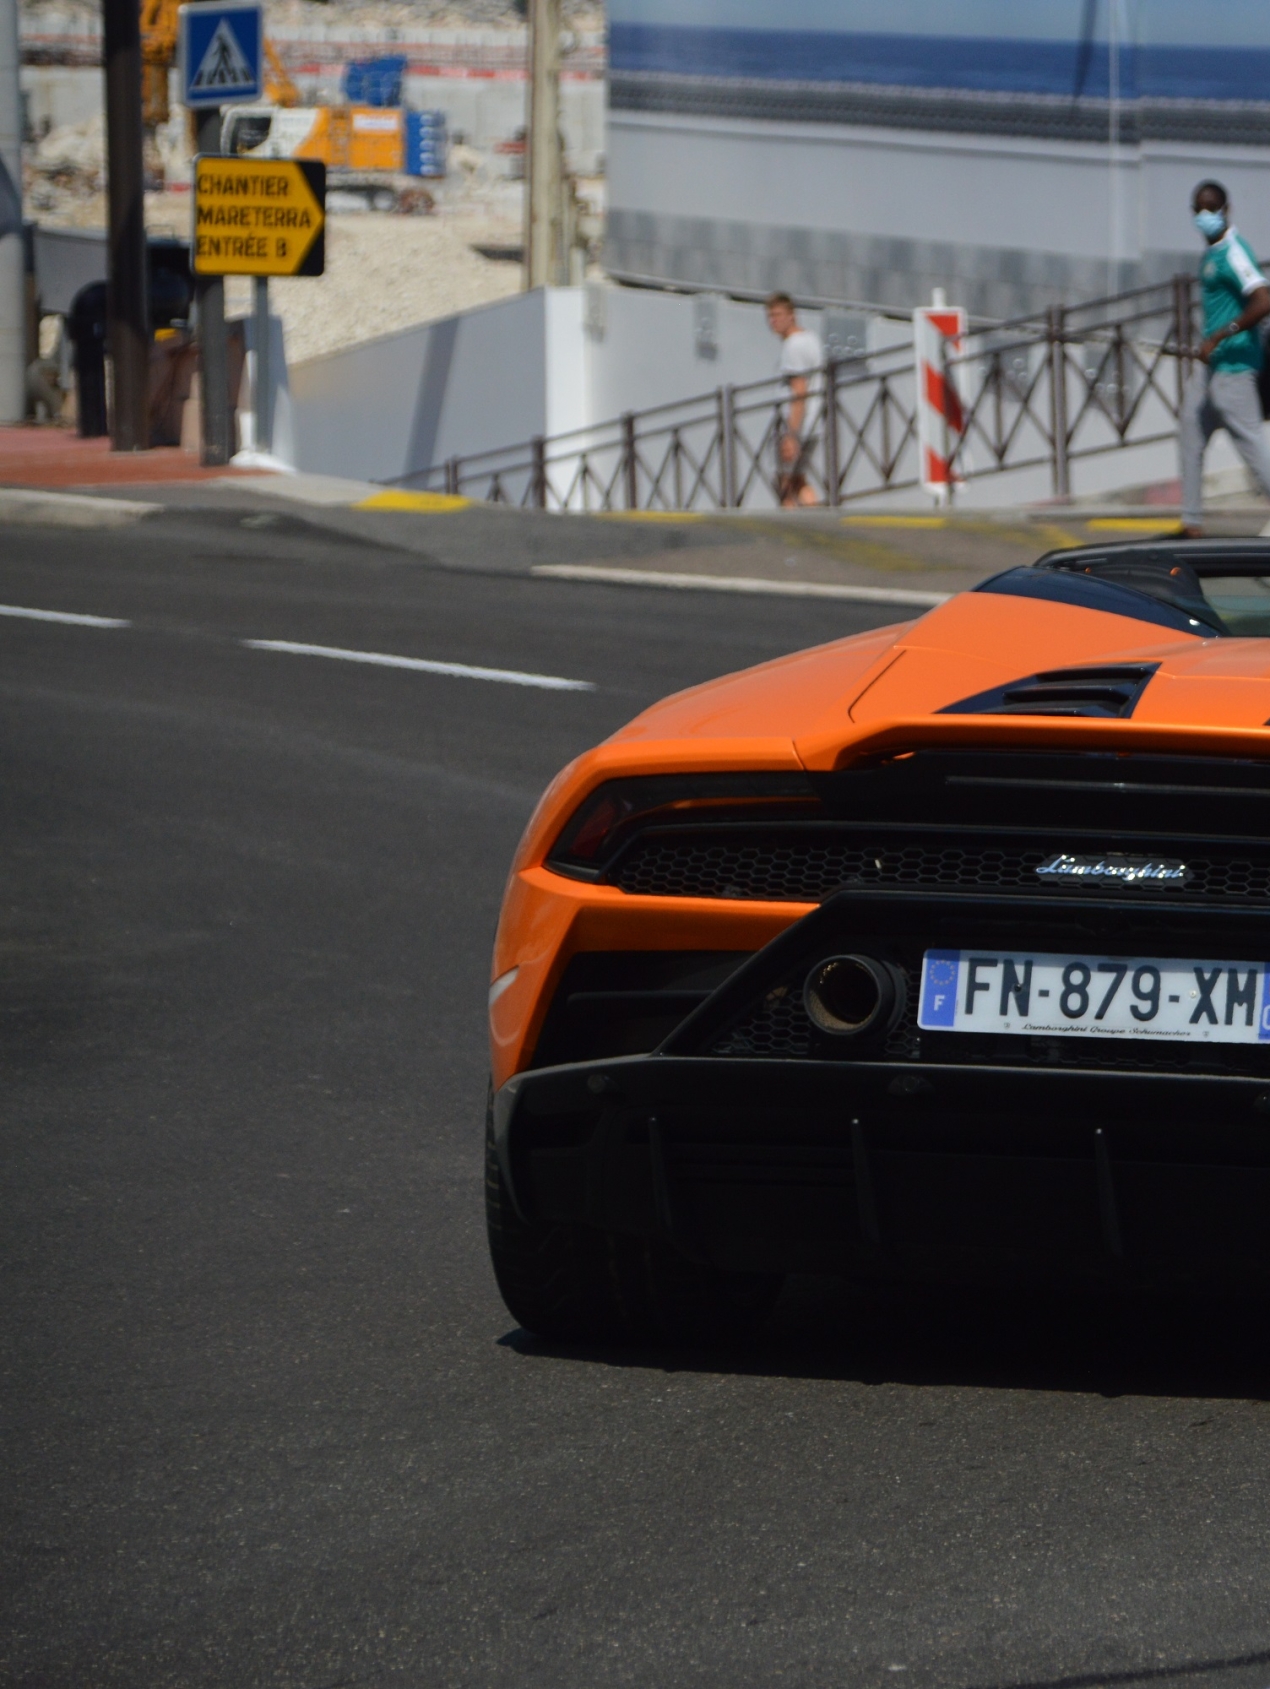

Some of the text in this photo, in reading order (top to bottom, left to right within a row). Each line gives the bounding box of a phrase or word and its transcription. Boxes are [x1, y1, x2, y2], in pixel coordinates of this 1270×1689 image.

[197, 173, 288, 196] CHANTIER
[197, 204, 311, 228] MARETERRA
[196, 231, 287, 258] ENTRÉE B
[1036, 854, 1185, 881] Lamborghini
[934, 994, 946, 1011] F
[965, 957, 1258, 1027] FN-879-XM
